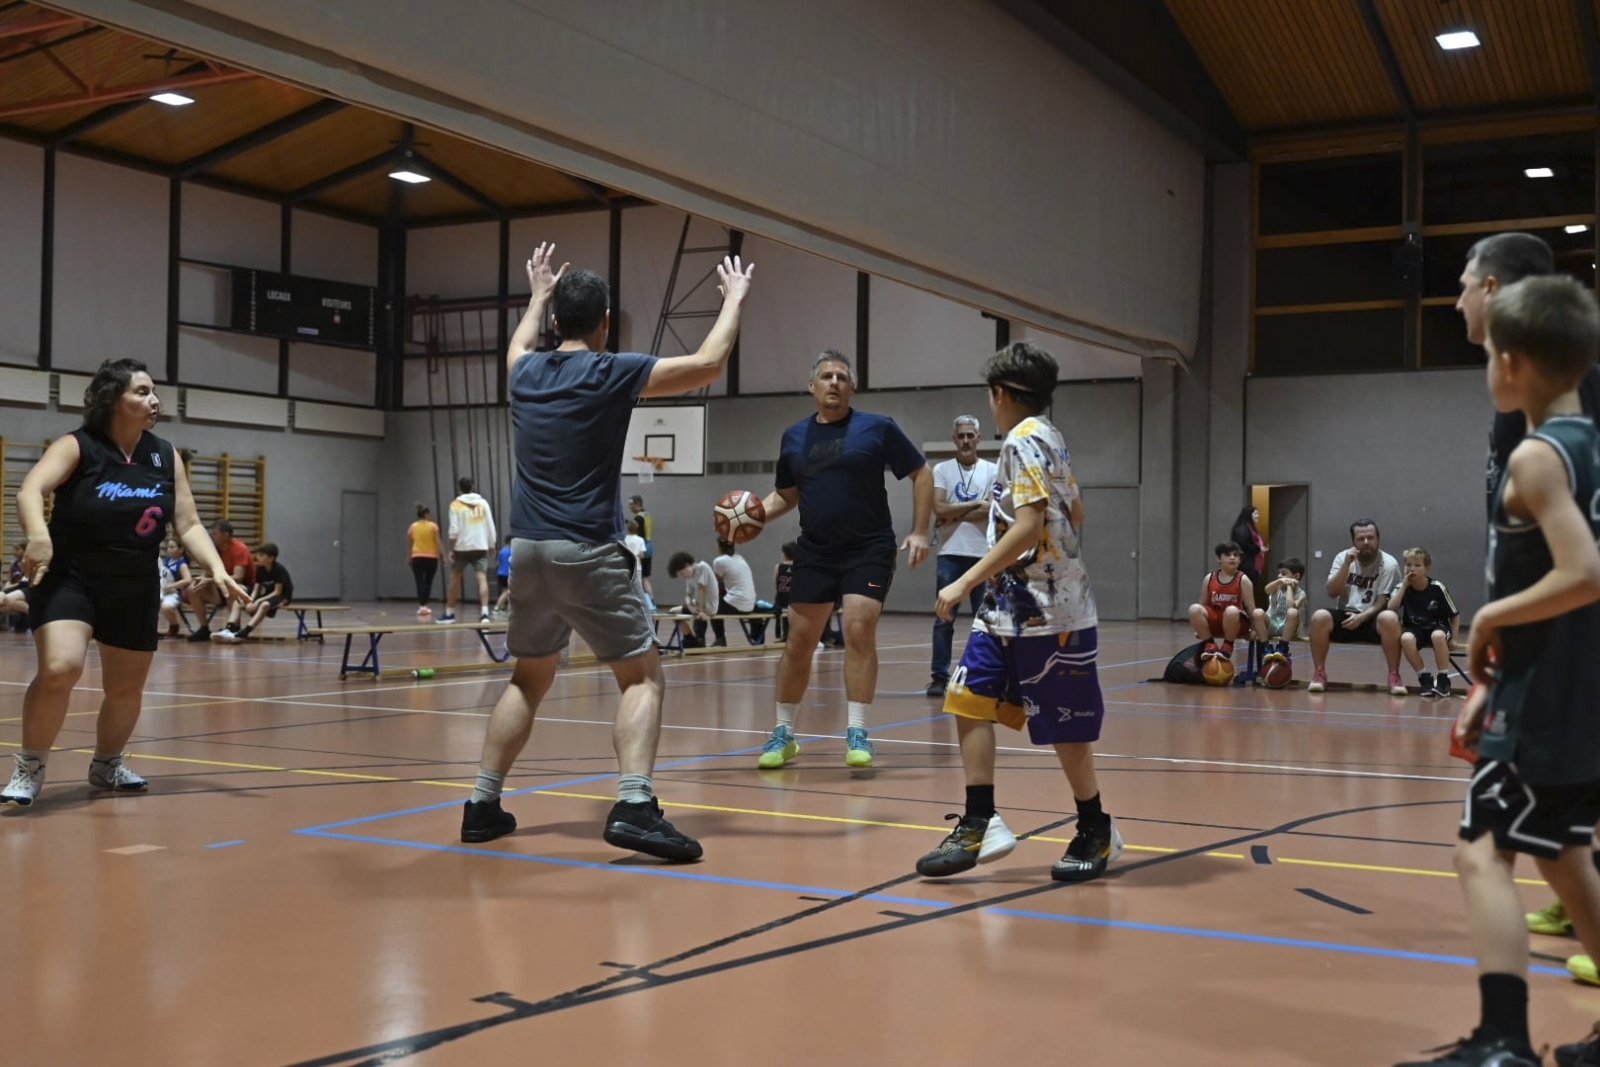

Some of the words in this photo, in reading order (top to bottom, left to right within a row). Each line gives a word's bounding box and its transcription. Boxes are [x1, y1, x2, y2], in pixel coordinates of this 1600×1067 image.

[267, 289, 291, 302] LOCAUX
[322, 297, 352, 310] VISITEURS
[96, 481, 163, 501] Miami
[135, 506, 164, 536] 6
[1361, 590, 1374, 604] 3
